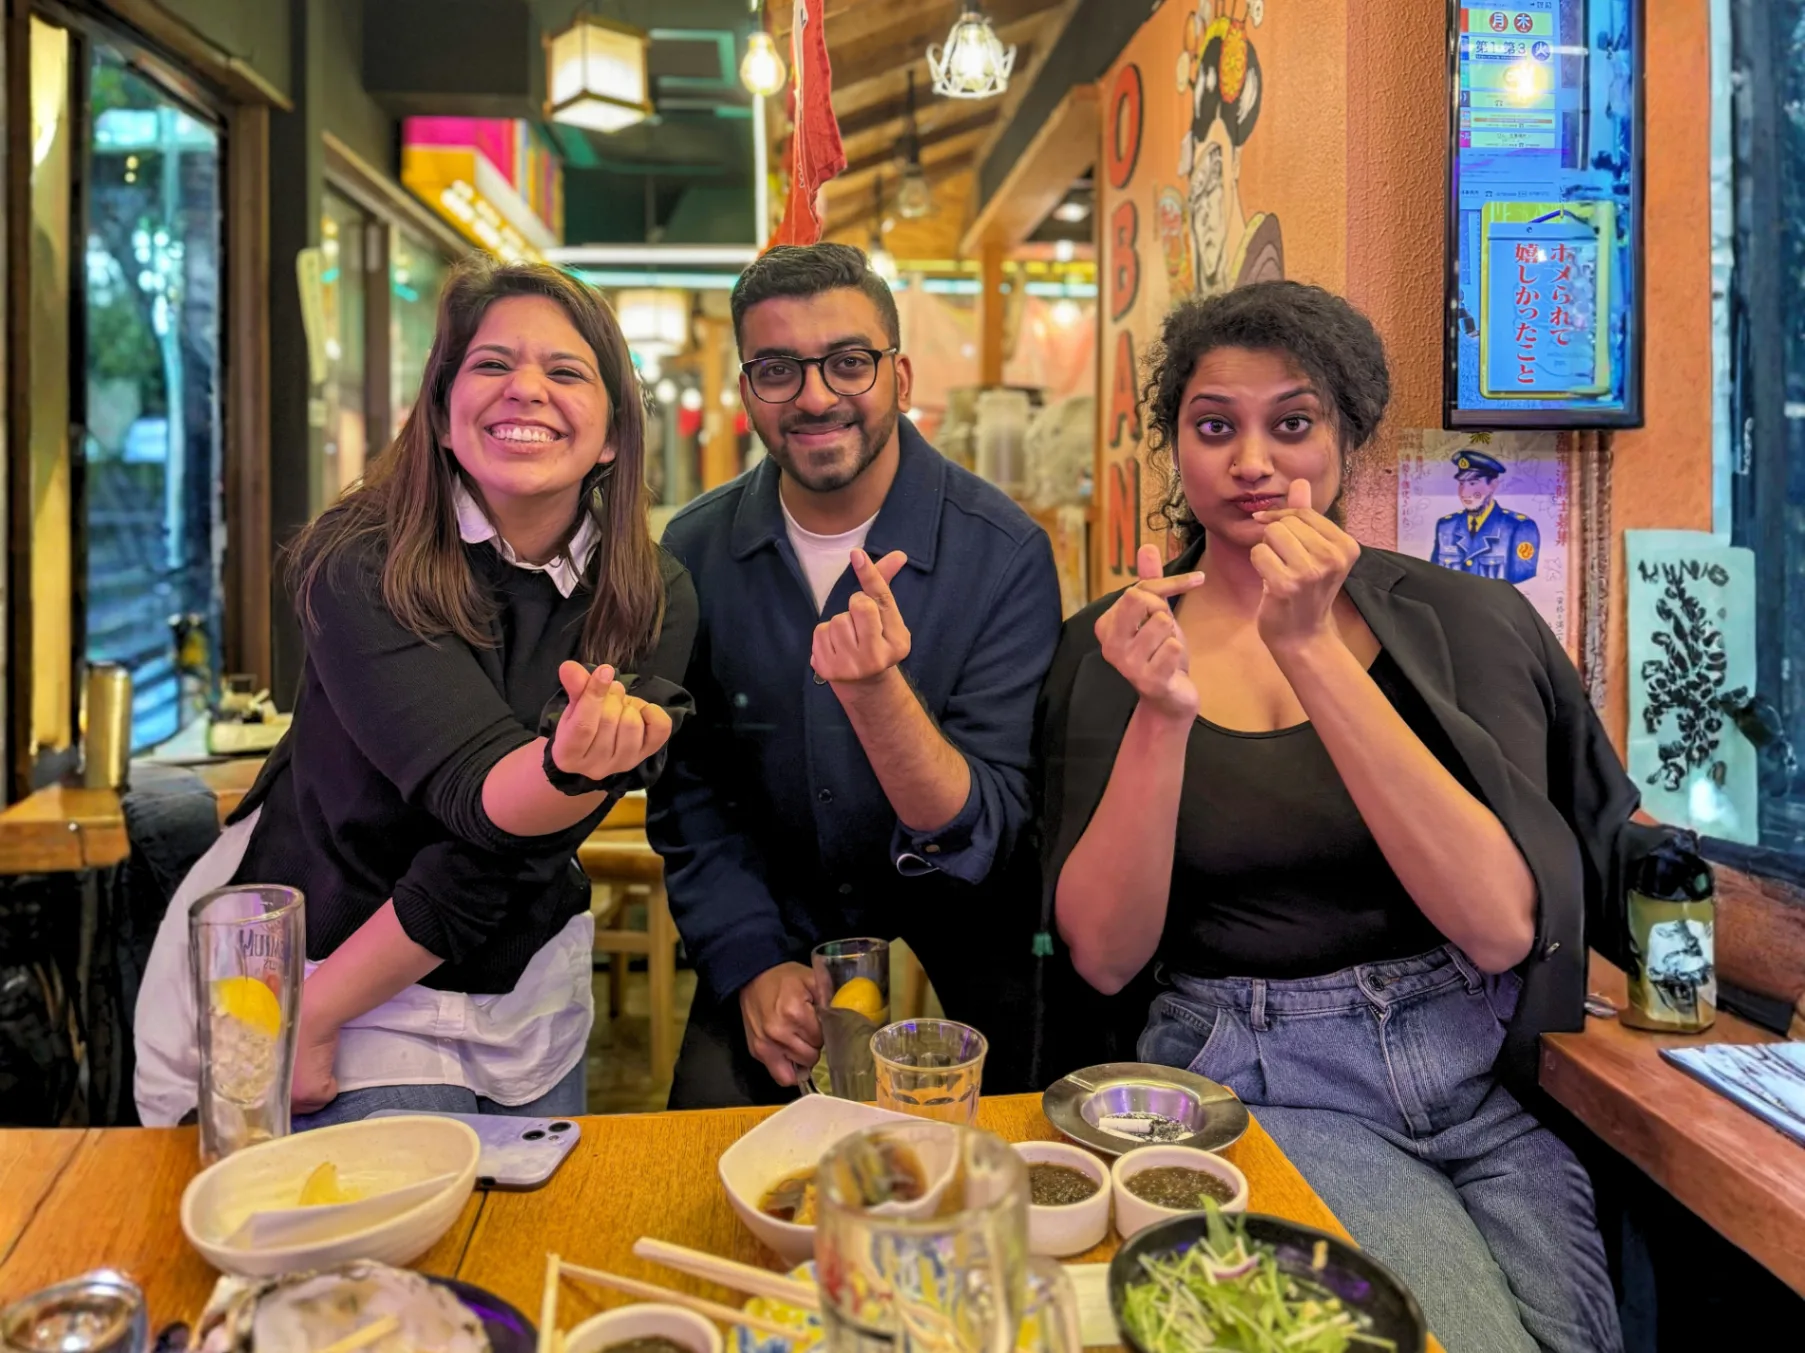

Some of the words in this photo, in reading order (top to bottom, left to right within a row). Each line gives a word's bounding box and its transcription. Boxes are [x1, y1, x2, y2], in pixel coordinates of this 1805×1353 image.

[1492, 13, 1505, 28] 月
[1516, 14, 1531, 29] 木
[1107, 62, 1144, 576] OBAN
[1515, 243, 1540, 383] 嬉しかったこと
[1550, 243, 1572, 346] ホメられて
